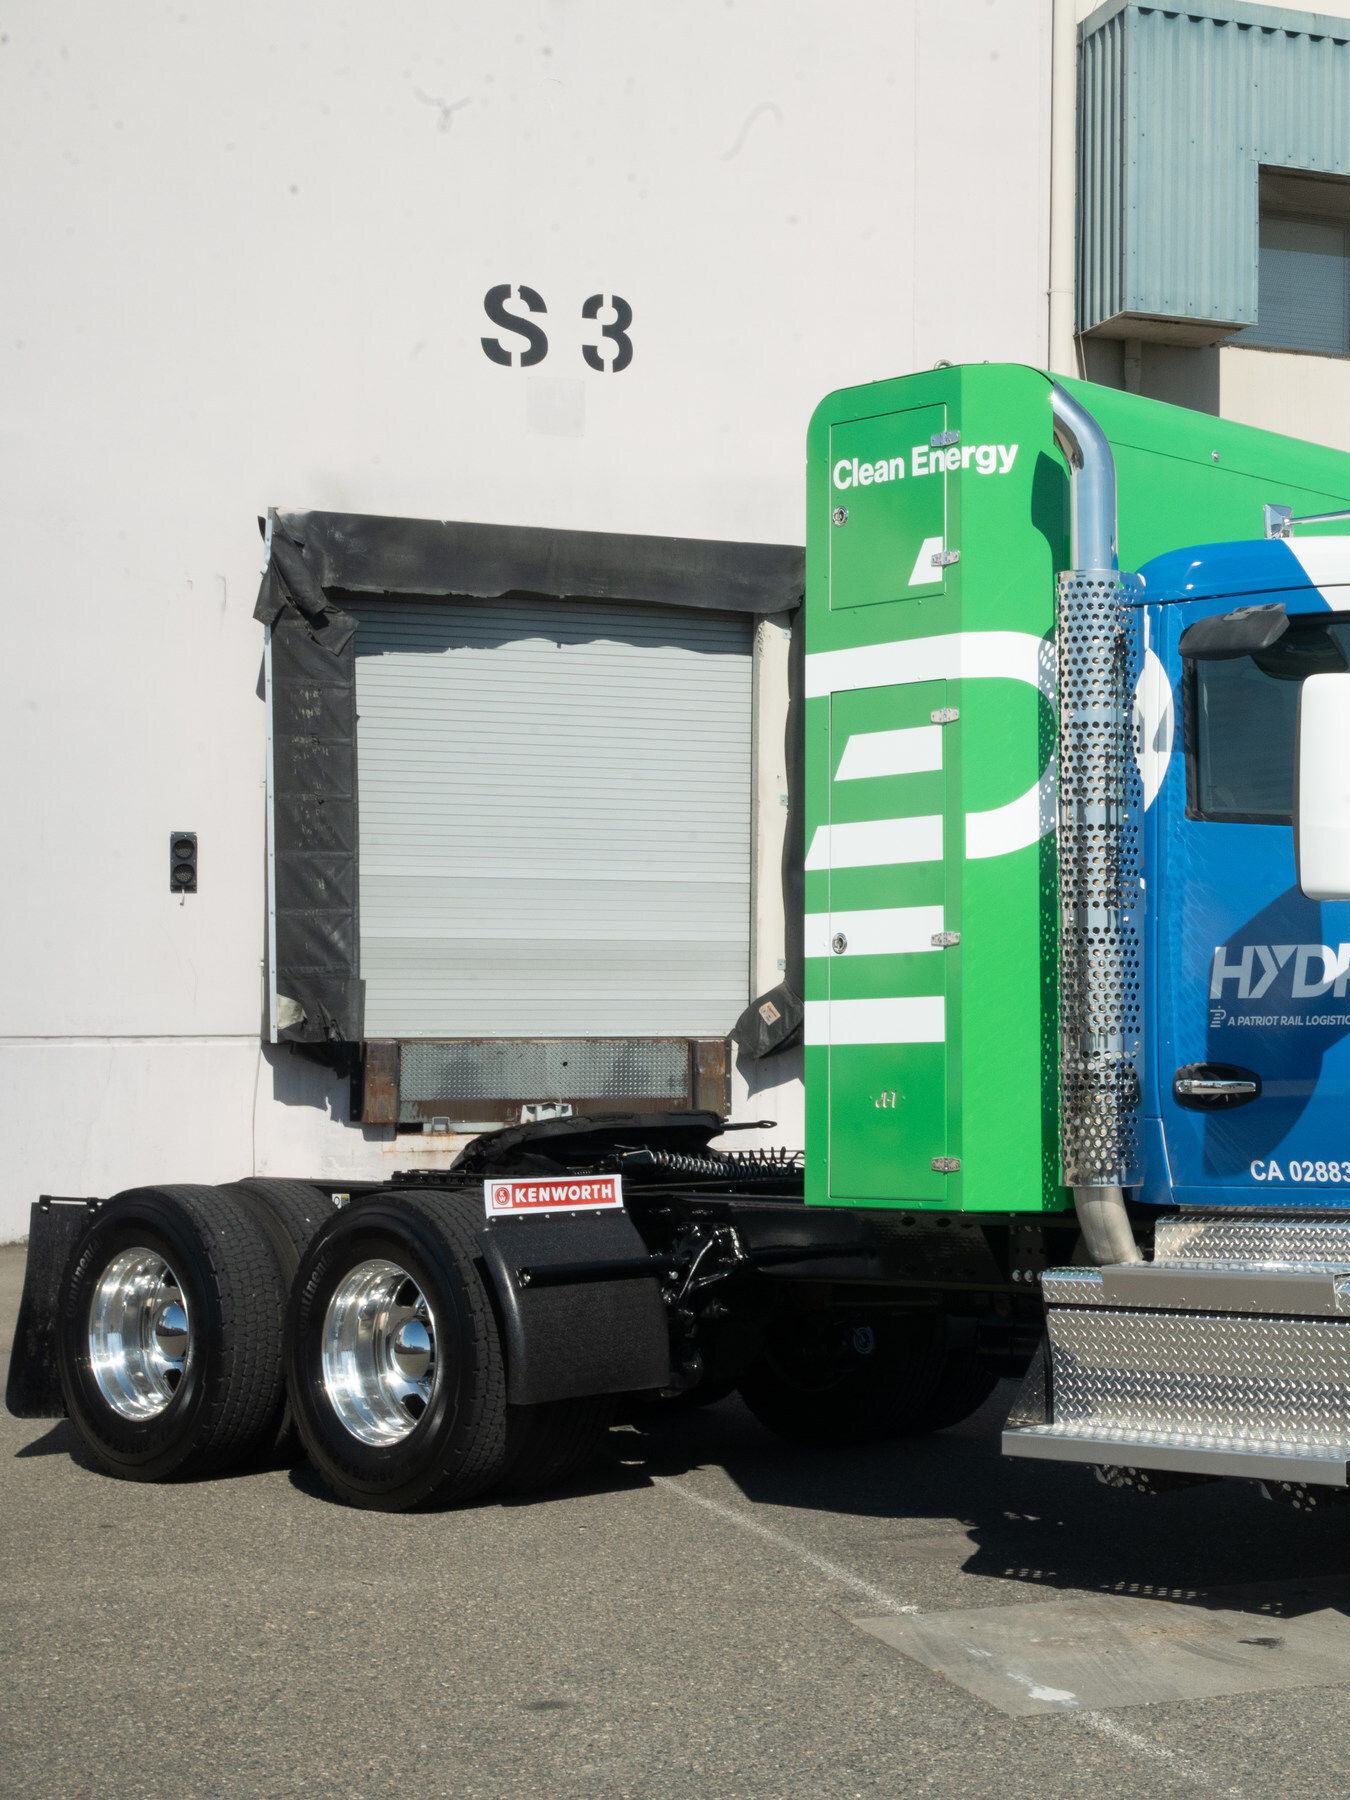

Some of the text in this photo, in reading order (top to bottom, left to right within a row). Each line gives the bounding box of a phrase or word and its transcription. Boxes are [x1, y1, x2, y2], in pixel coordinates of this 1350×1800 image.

[481, 284, 633, 373] S 3
[832, 444, 1019, 490] Clean Energy
[1227, 1016, 1236, 1026] A
[1237, 1015, 1279, 1026] PATRIOT
[1280, 1015, 1304, 1026] RAIL
[1250, 1160, 1285, 1182] CA
[515, 1183, 613, 1203] KENWORTH
